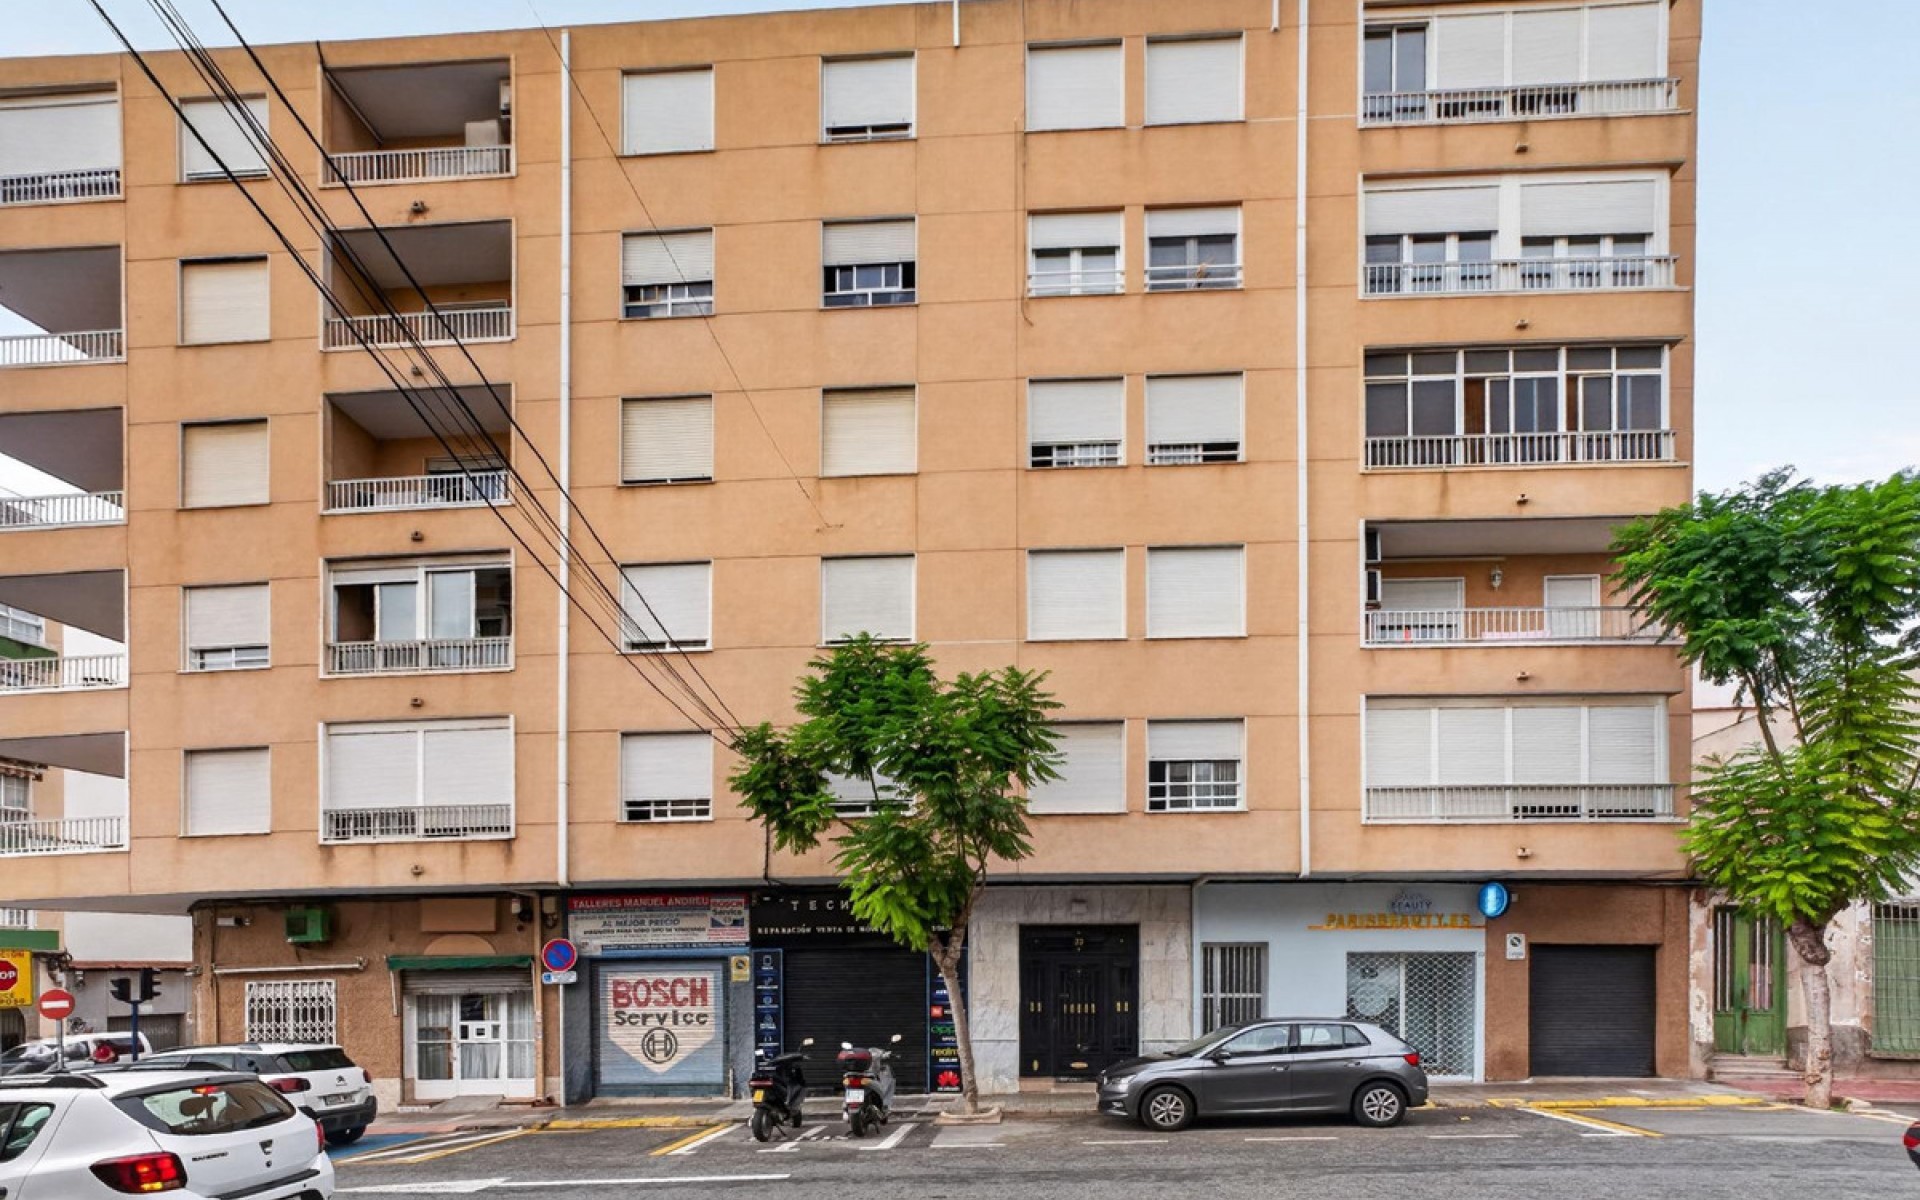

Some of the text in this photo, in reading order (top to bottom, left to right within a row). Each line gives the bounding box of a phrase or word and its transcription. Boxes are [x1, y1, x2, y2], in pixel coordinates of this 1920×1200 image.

[573, 898, 621, 909] TALLERES
[624, 897, 664, 907] MANUEL
[1391, 901, 1432, 910] BEAUTY
[616, 918, 645, 927] MEJOR
[649, 917, 680, 926] PRECIO
[612, 977, 708, 1008] BOSCH
[614, 1010, 708, 1025] Service
